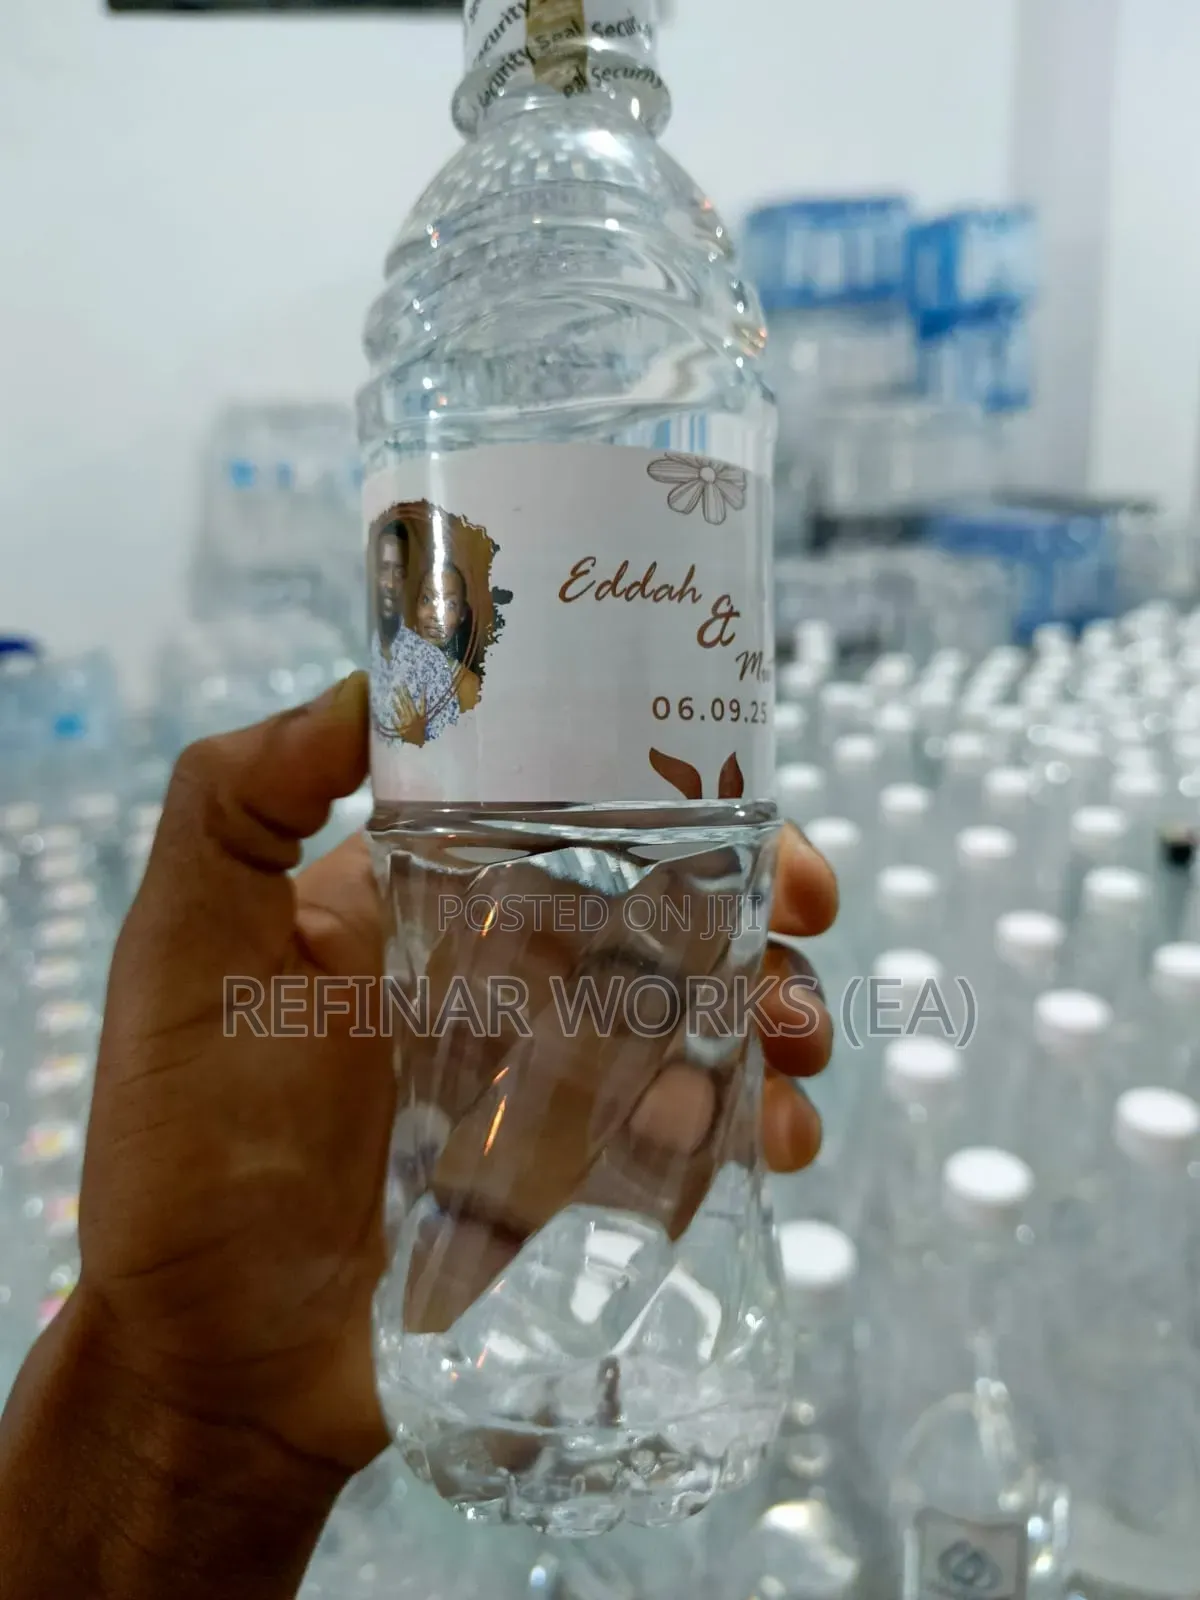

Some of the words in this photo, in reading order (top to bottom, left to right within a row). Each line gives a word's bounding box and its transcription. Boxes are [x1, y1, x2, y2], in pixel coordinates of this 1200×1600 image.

[474, 0, 530, 62] ecurity
[534, 18, 583, 50] Seal
[563, 64, 591, 98] eal
[558, 556, 702, 604] Eddah
[697, 594, 741, 649] &
[652, 696, 767, 724] 06.09.25
